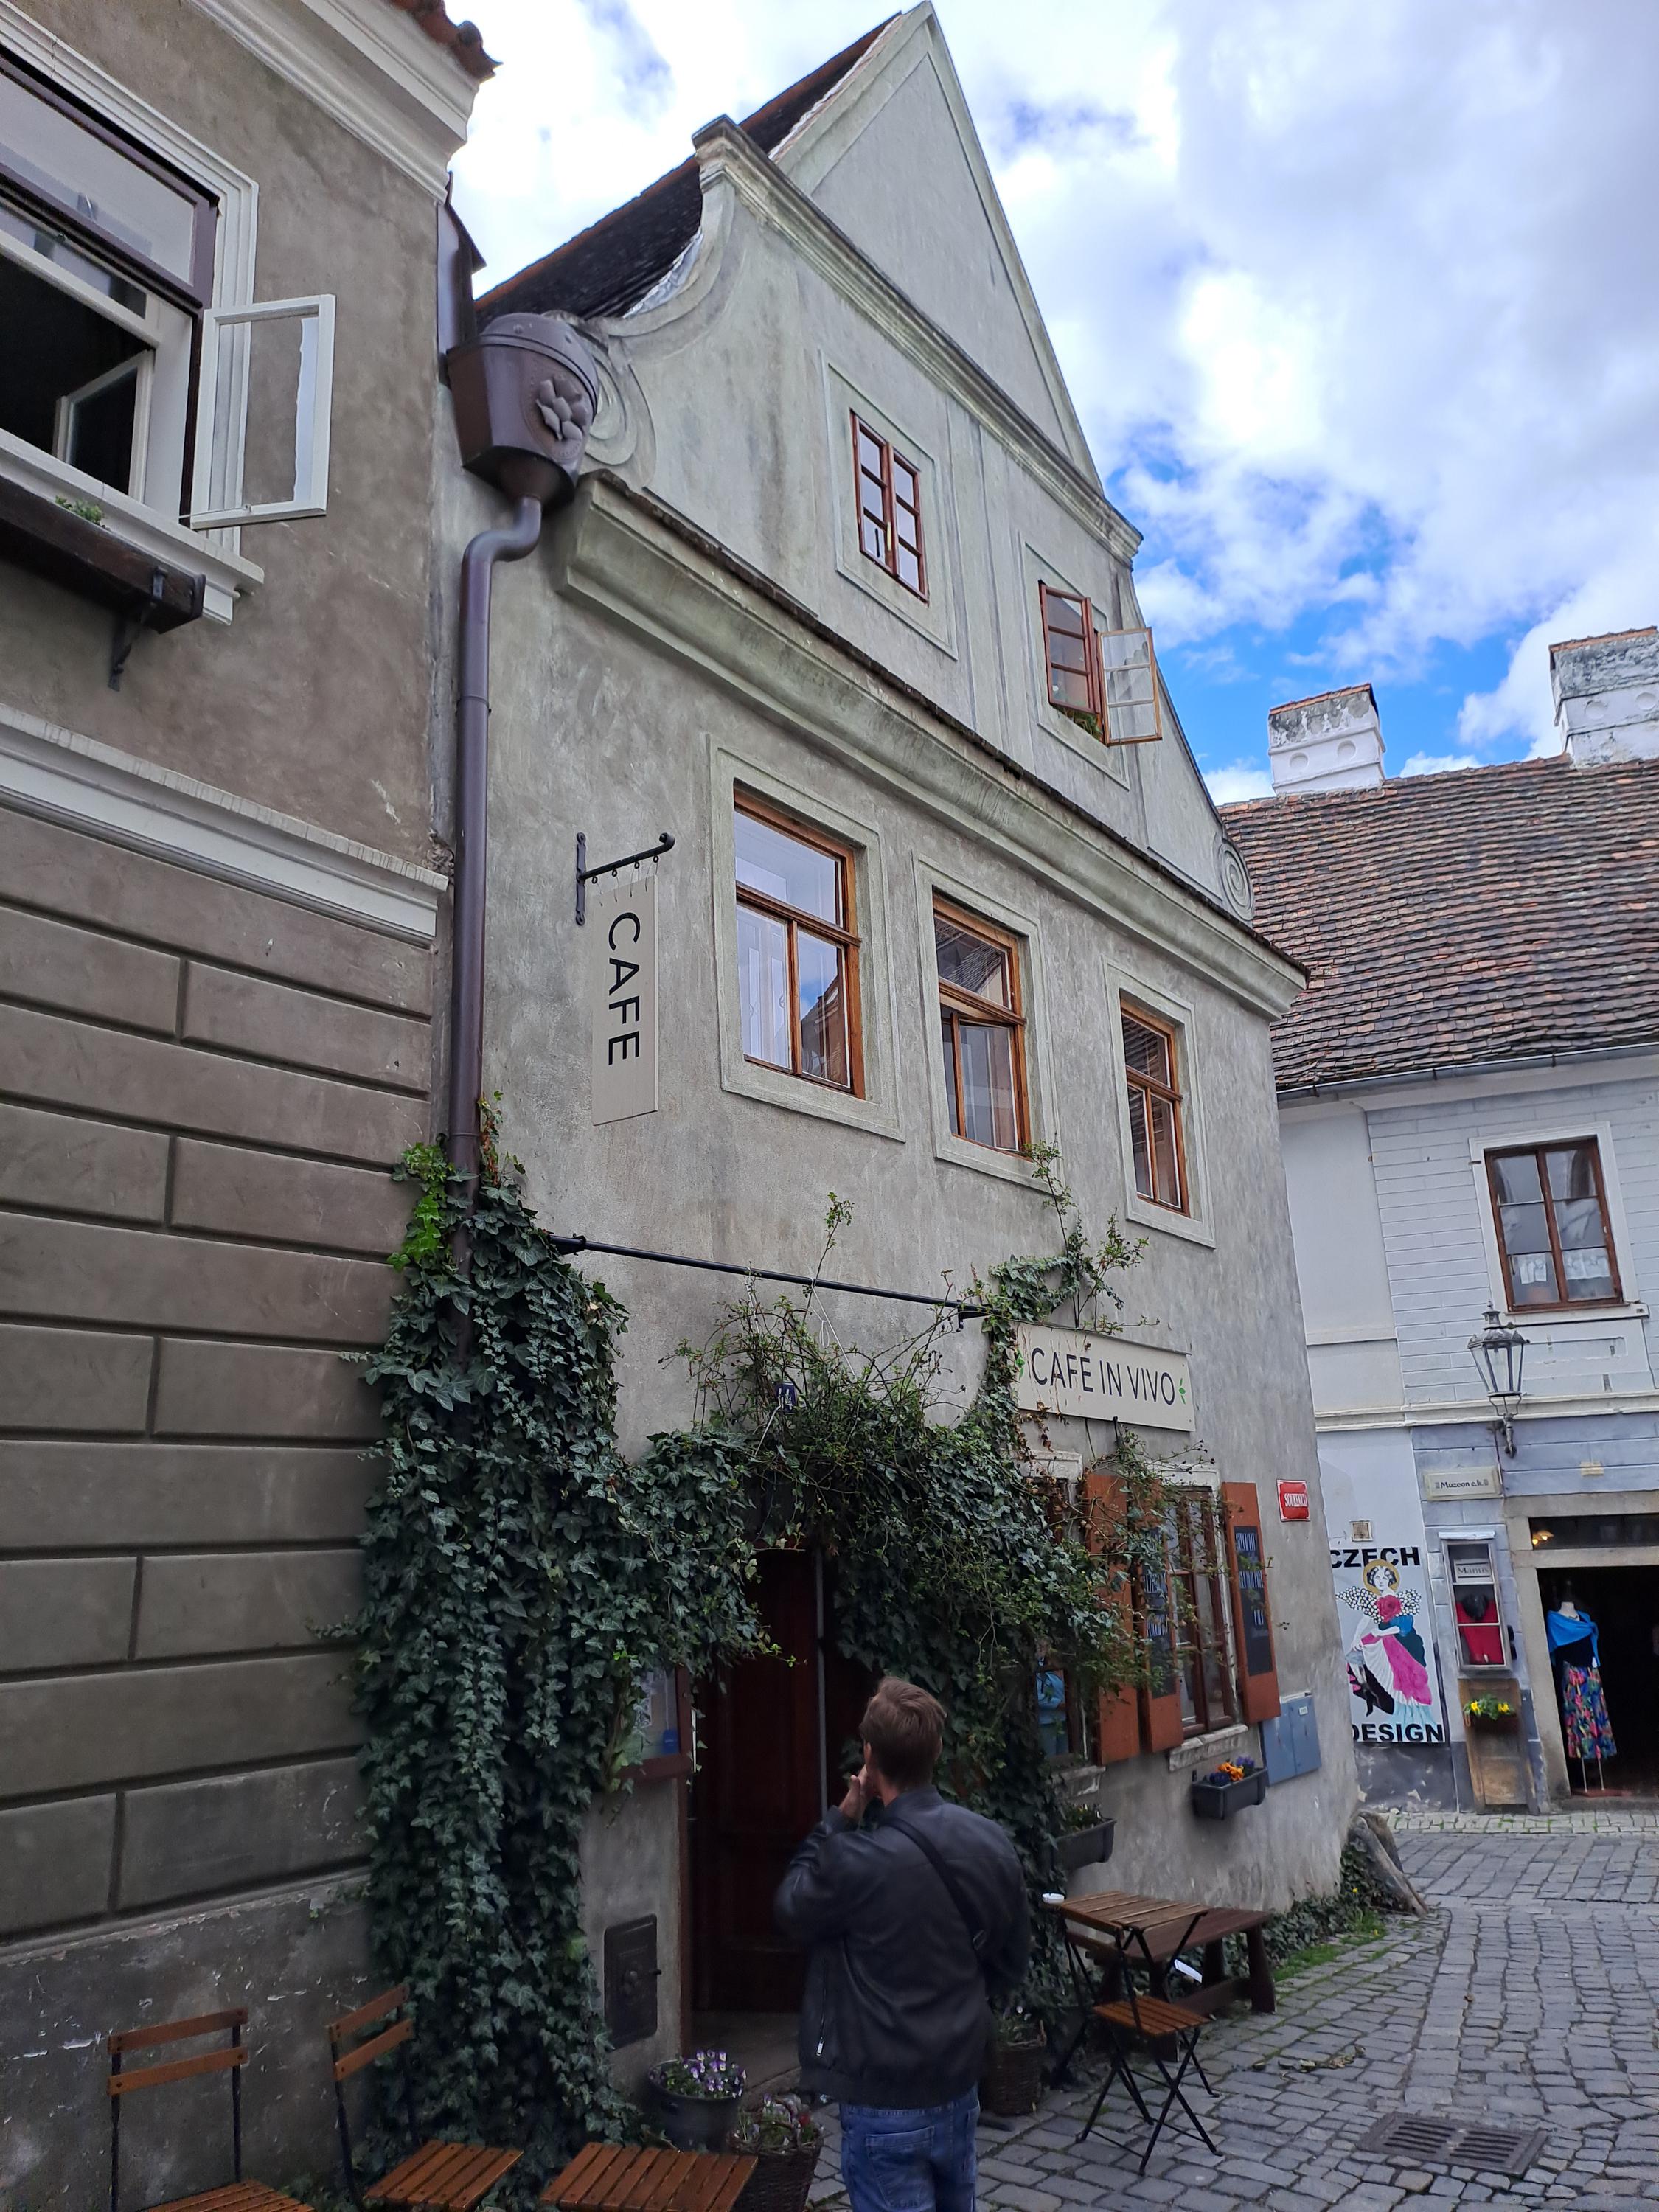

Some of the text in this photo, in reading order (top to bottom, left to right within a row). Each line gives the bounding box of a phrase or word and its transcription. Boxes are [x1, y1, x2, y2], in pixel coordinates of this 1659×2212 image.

[608, 912, 640, 1065] CAFE
[1032, 1347, 1175, 1405] CAFE IN VIVO
[1329, 1547, 1420, 1568] CZECH
